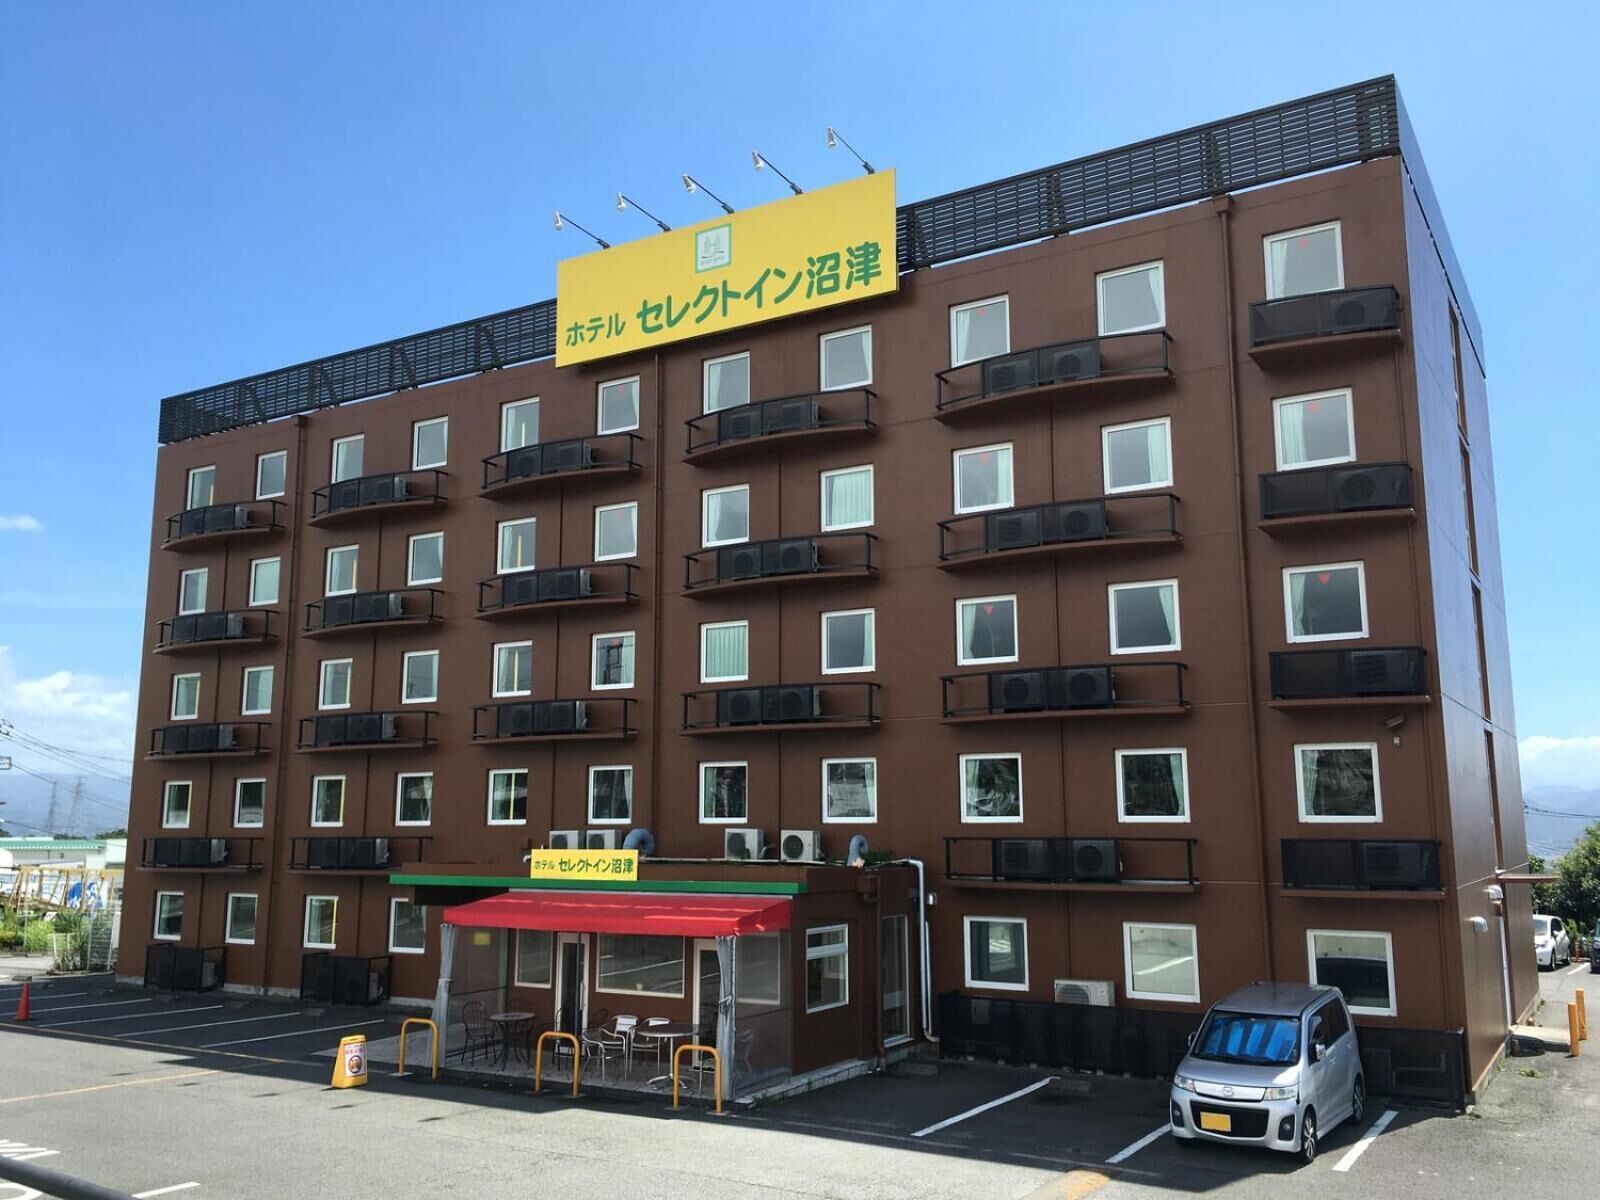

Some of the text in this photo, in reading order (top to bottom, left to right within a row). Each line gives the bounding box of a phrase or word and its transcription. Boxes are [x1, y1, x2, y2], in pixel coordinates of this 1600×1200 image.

[566, 241, 882, 347] ホテル セレクトイン沼津
[534, 858, 634, 874] ホテル セレクトイン沼津
